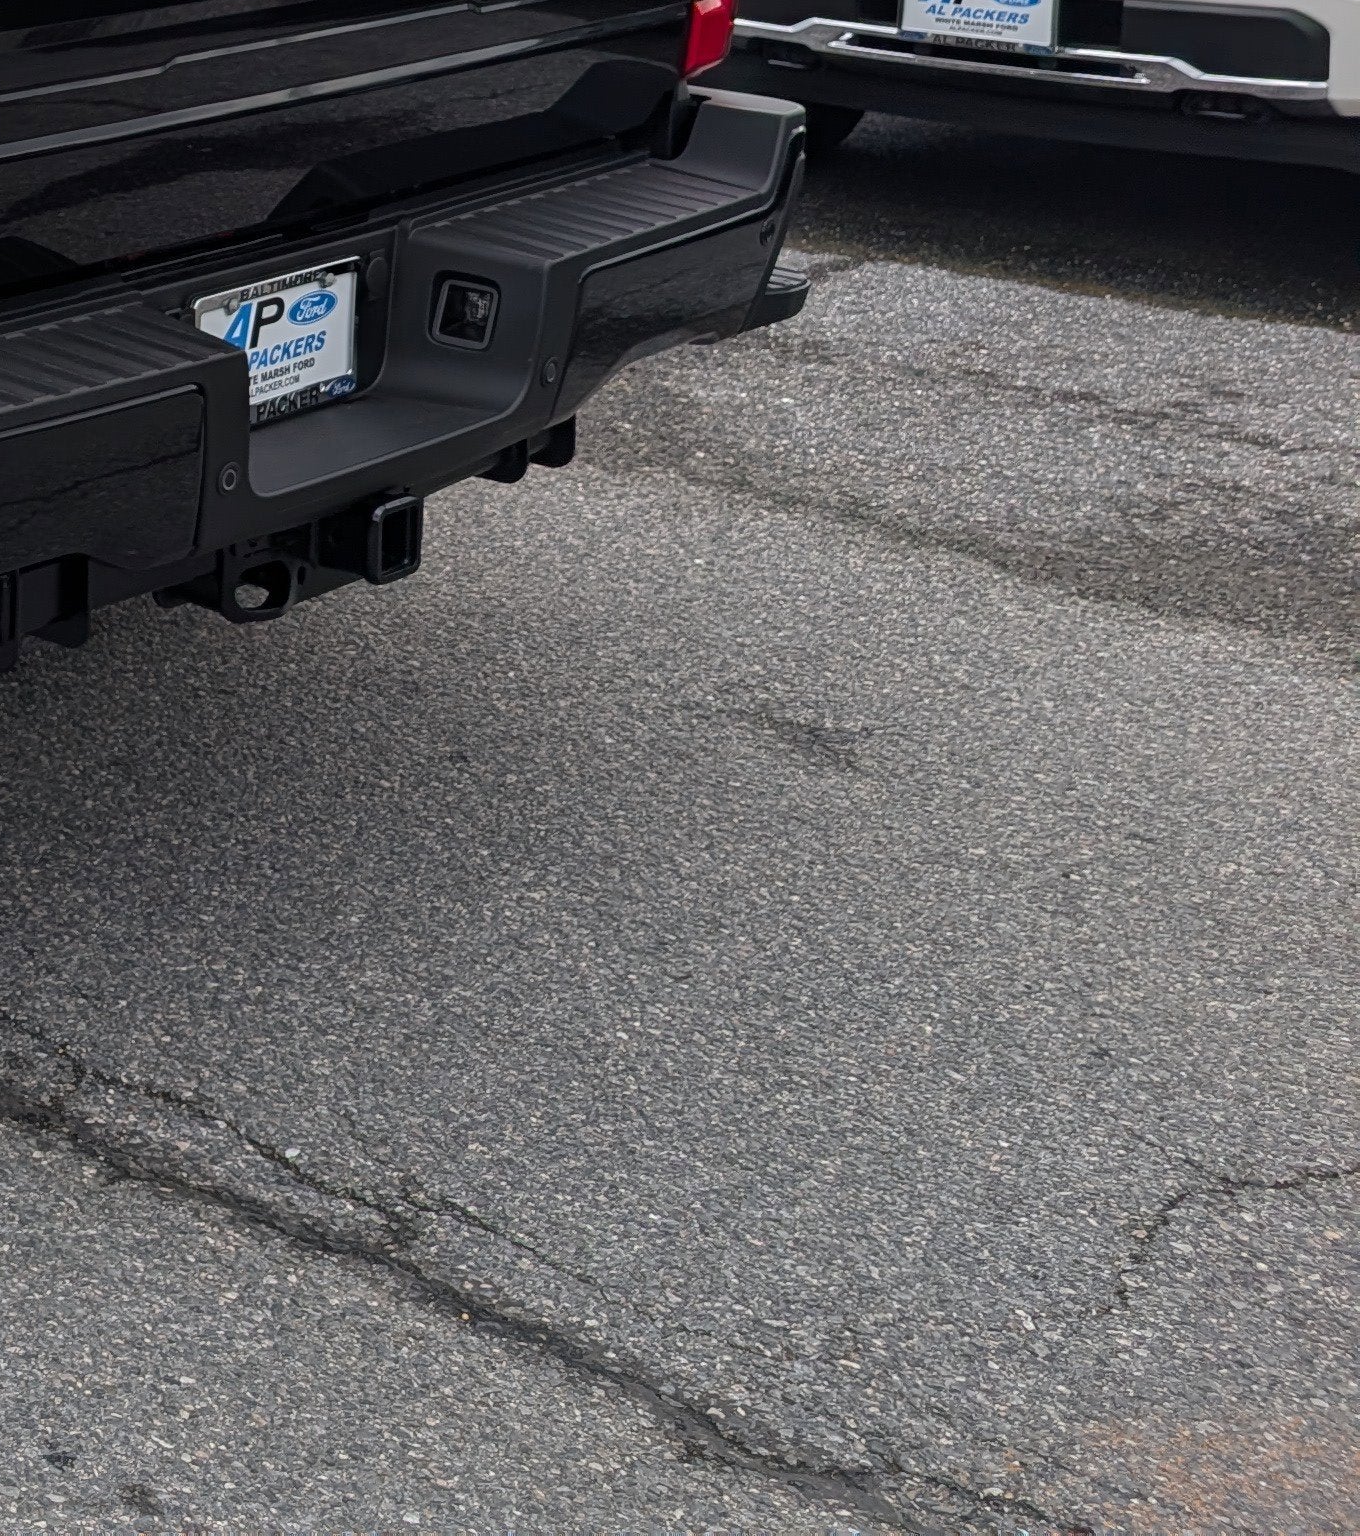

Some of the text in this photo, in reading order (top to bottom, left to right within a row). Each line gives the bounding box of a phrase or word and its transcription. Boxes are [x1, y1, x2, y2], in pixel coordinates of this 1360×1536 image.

[925, 4, 1030, 25] AL PACKERS
[239, 270, 321, 302] BALTIMORE
[297, 295, 328, 322] Ford
[248, 330, 327, 372] PACKERS
[261, 364, 291, 382] MARSH
[293, 357, 315, 373] FORD
[256, 387, 321, 422] PACKER
